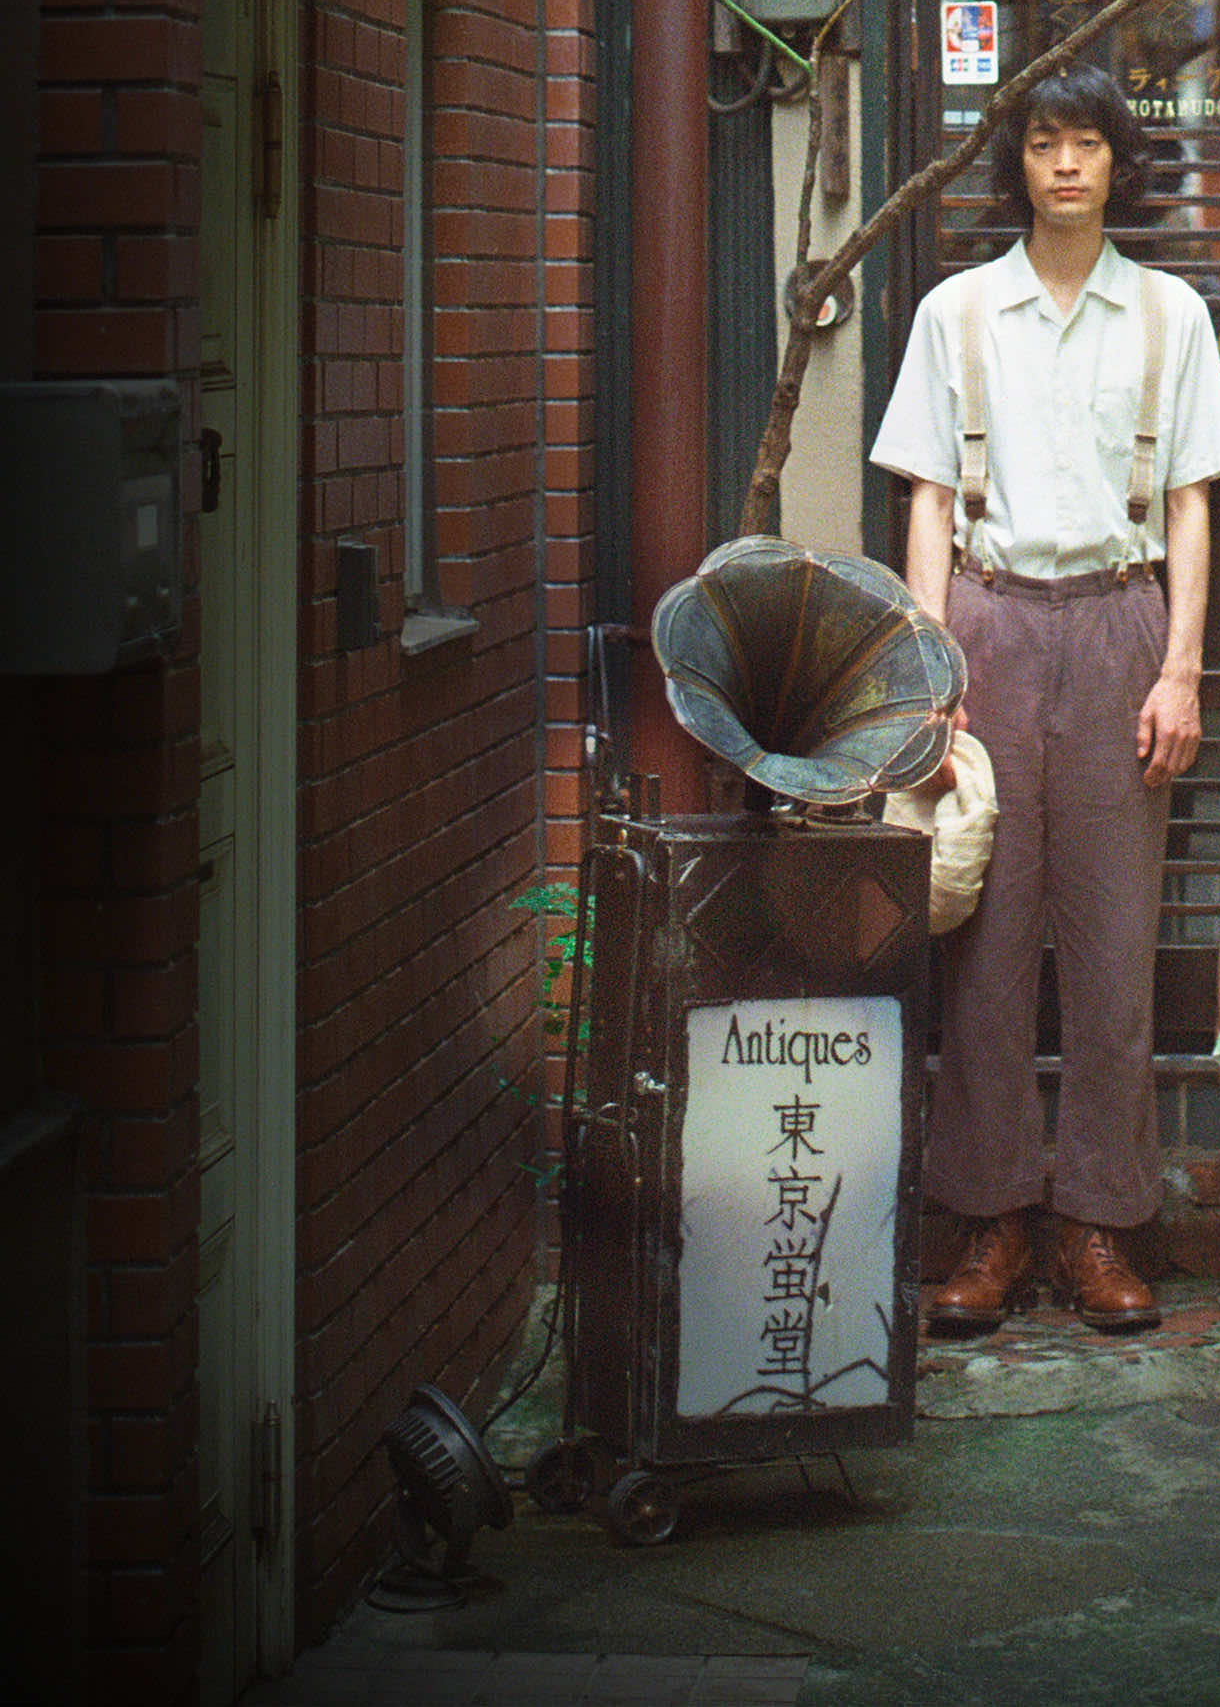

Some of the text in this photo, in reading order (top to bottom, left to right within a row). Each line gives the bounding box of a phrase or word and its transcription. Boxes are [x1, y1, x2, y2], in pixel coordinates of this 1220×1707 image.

[720, 1013, 874, 1085] Antiques
[755, 1094, 824, 1379] 東京蛍堂
